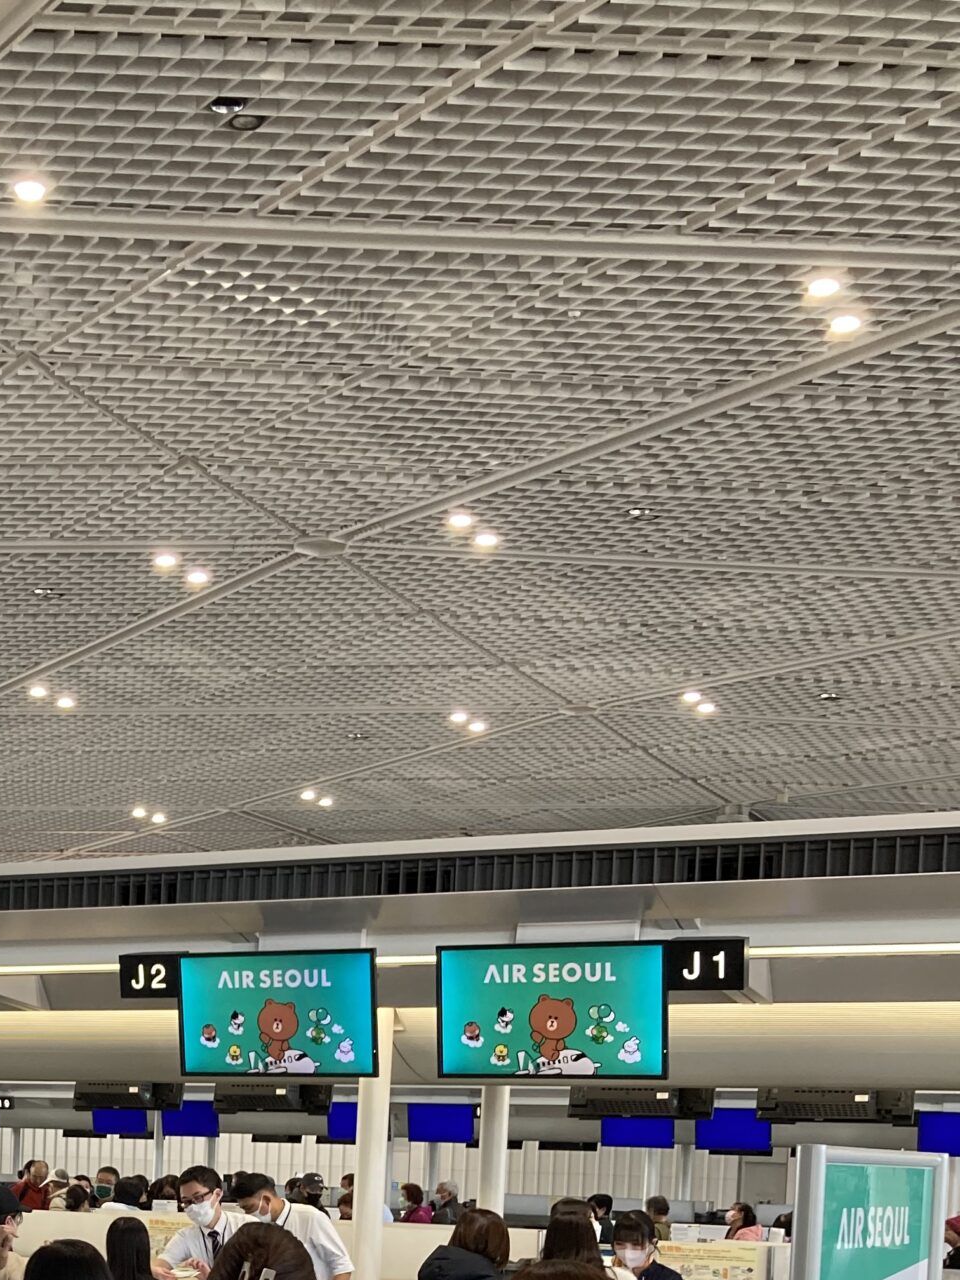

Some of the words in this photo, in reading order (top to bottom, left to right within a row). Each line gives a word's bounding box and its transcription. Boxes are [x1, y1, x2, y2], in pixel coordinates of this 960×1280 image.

[218, 970, 255, 989] AIR
[259, 968, 332, 988] SEOUL
[484, 964, 527, 984] AIR
[532, 962, 617, 983] SEOUL
[836, 1207, 865, 1250] AIR
[866, 1206, 910, 1248] SEOUL
